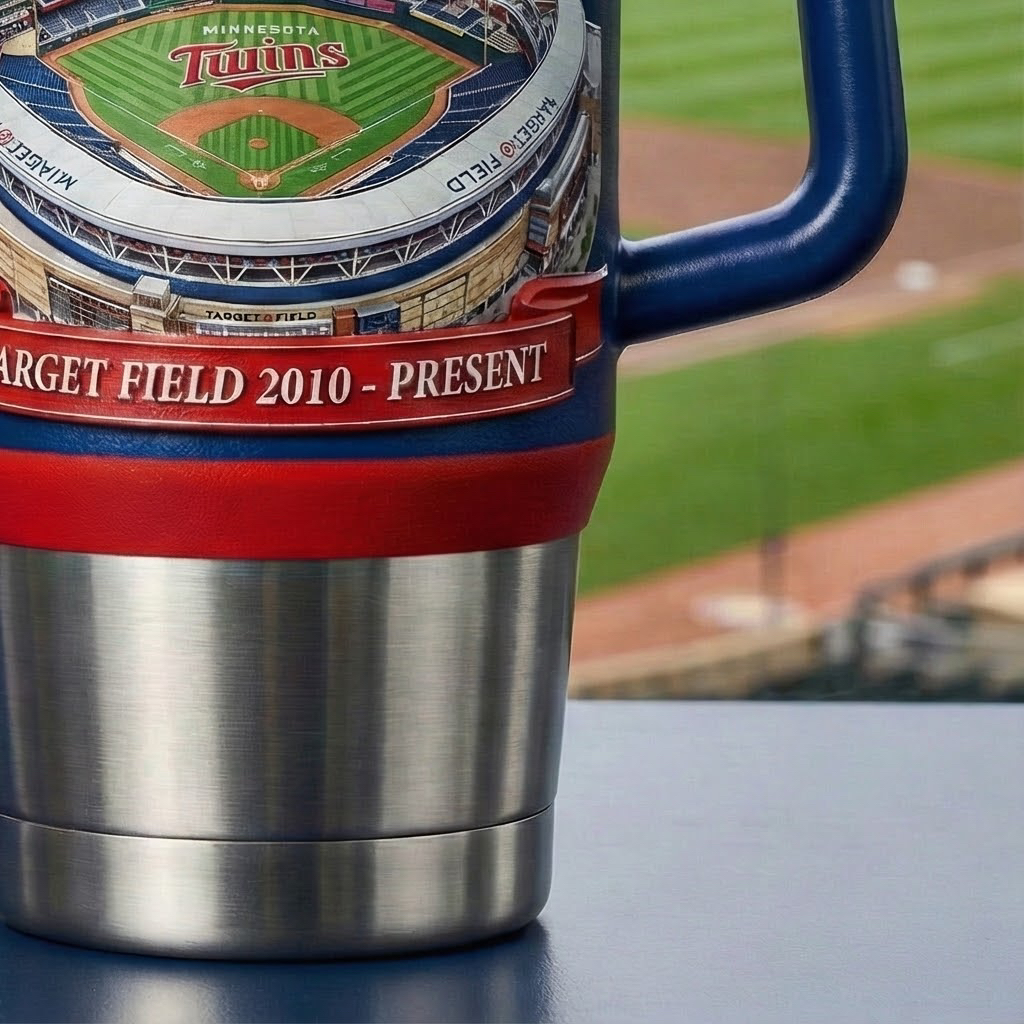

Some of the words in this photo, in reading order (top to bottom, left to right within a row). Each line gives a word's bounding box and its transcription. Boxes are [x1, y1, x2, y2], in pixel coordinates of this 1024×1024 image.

[203, 24, 320, 36] MINNESOTA
[167, 36, 351, 93] Twins
[446, 152, 503, 193] FIELD
[117, 359, 245, 406] FIELD
[255, 365, 352, 406] 2010
[386, 340, 548, 402] PRESENT
